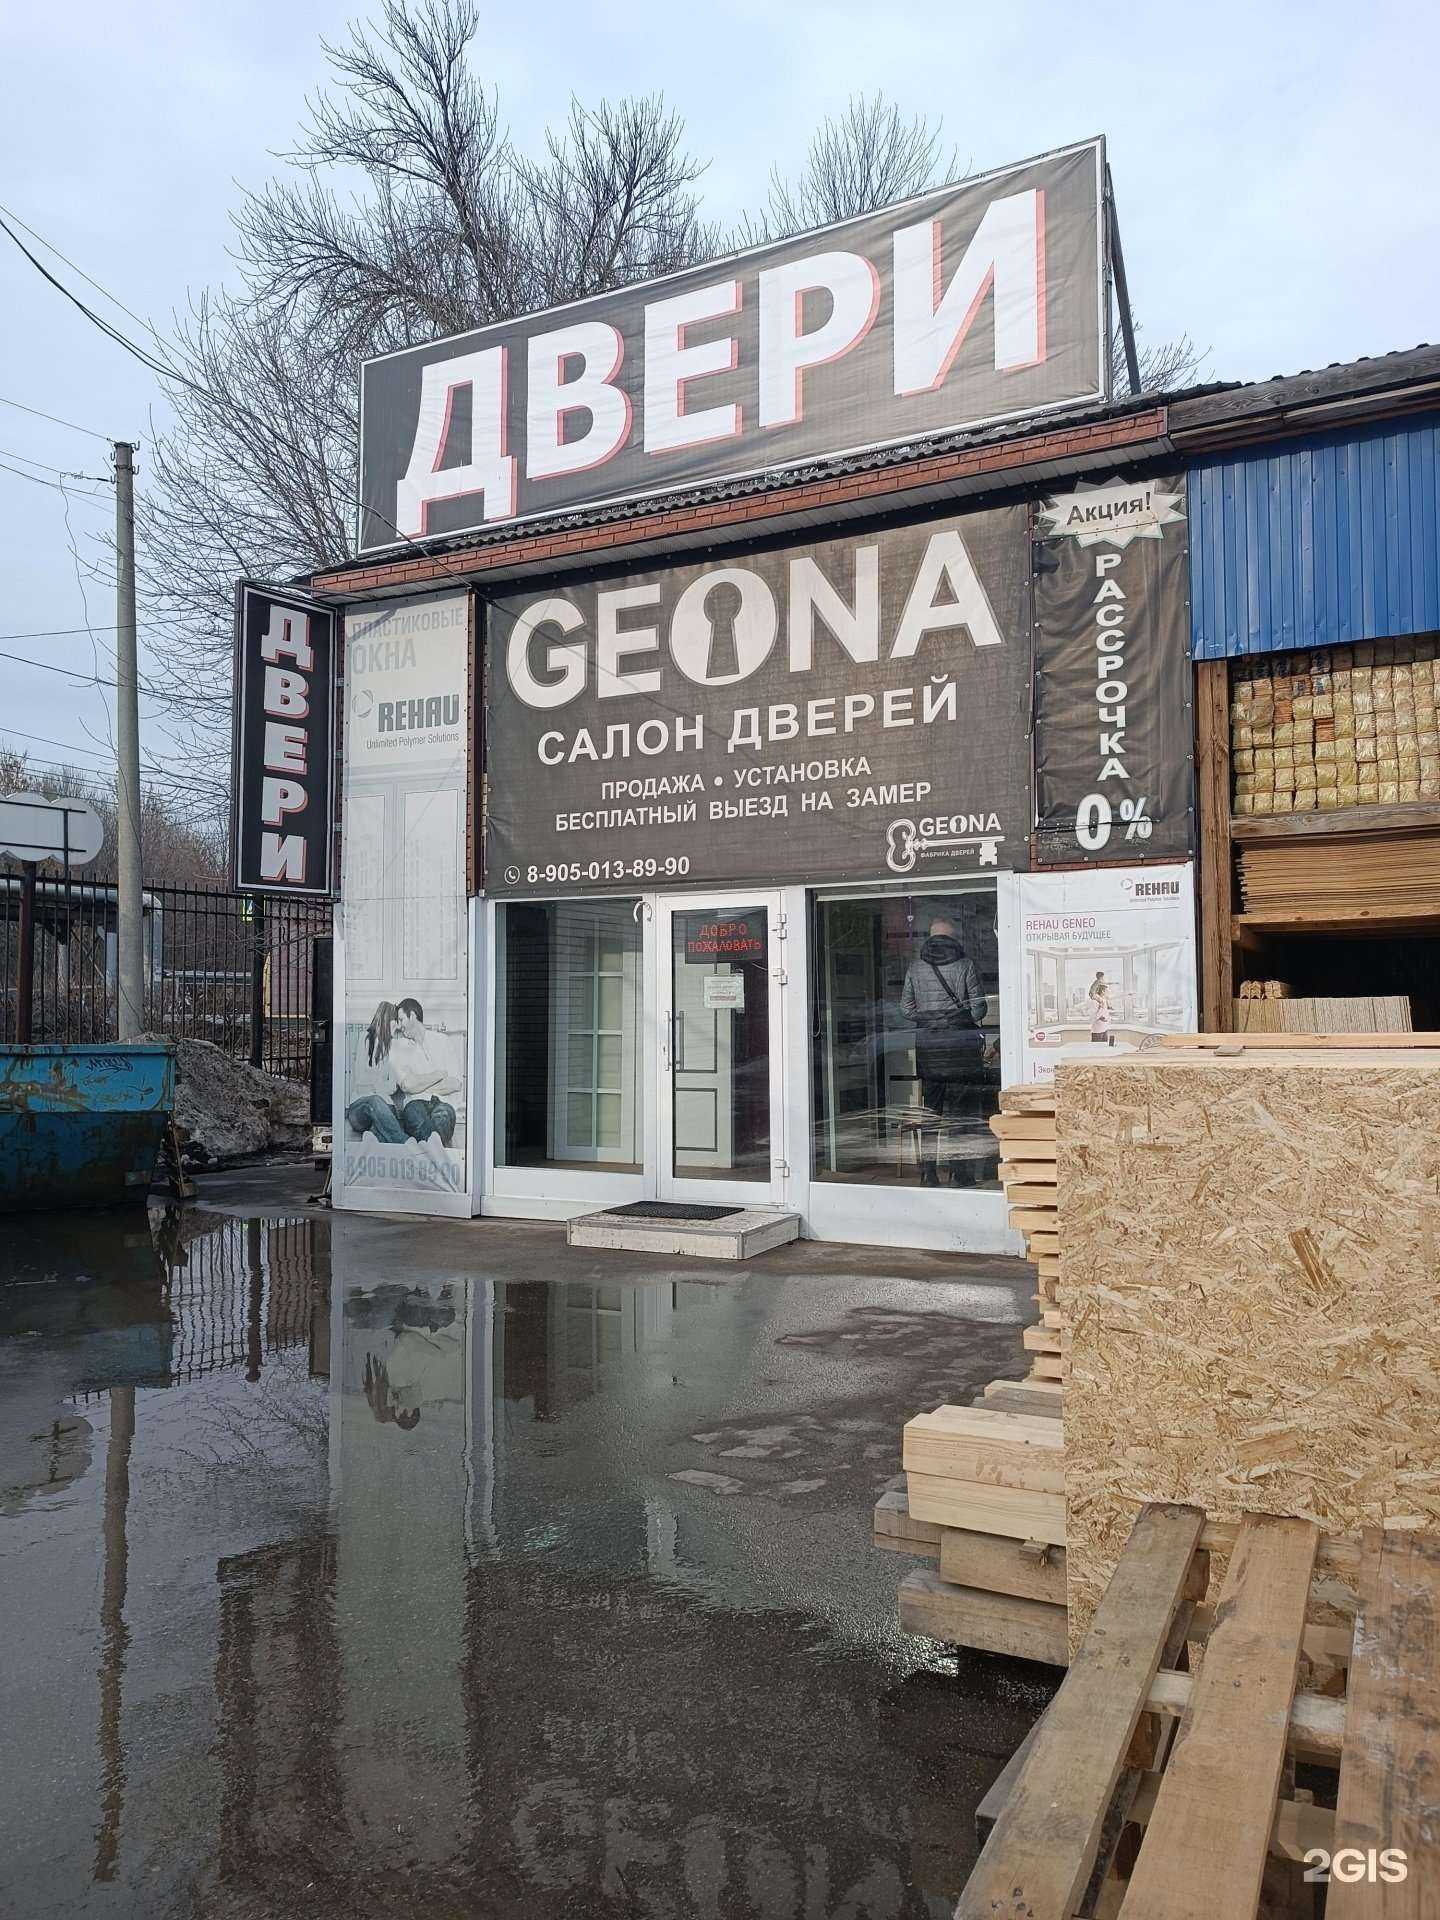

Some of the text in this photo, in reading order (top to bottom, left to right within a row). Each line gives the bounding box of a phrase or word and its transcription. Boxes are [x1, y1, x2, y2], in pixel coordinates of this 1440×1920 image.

[396, 188, 1047, 540] ДВЕРИ
[1067, 492, 1151, 526] Акция!
[505, 530, 1005, 709] GEONA
[352, 638, 417, 675] ОКНА
[1094, 554, 1131, 782] РАССРОЧКА
[378, 694, 460, 733] REHAU
[537, 673, 958, 766] САЛОН ДВЕРЕЙ
[260, 604, 313, 883] ДВЕРИ
[366, 732, 460, 750] Unlimited Polymer Solutions
[601, 756, 872, 800] ПРОДАЖА УСТАНОВКА
[555, 782, 932, 832] БЕСПЛАТНЫЙ ВЫЕЗД НА ЗАМЕР
[919, 812, 1002, 837] GEONA
[527, 856, 690, 883] 8-905-013-89-90
[1135, 881, 1180, 896] REHAU
[700, 923, 747, 939] ДОБРО
[1026, 917, 1096, 930] REHAU GENEO
[1026, 932, 1070, 942] ОТКРЫВАЯ
[687, 938, 763, 953] ПОЖАЛОВАТЬ
